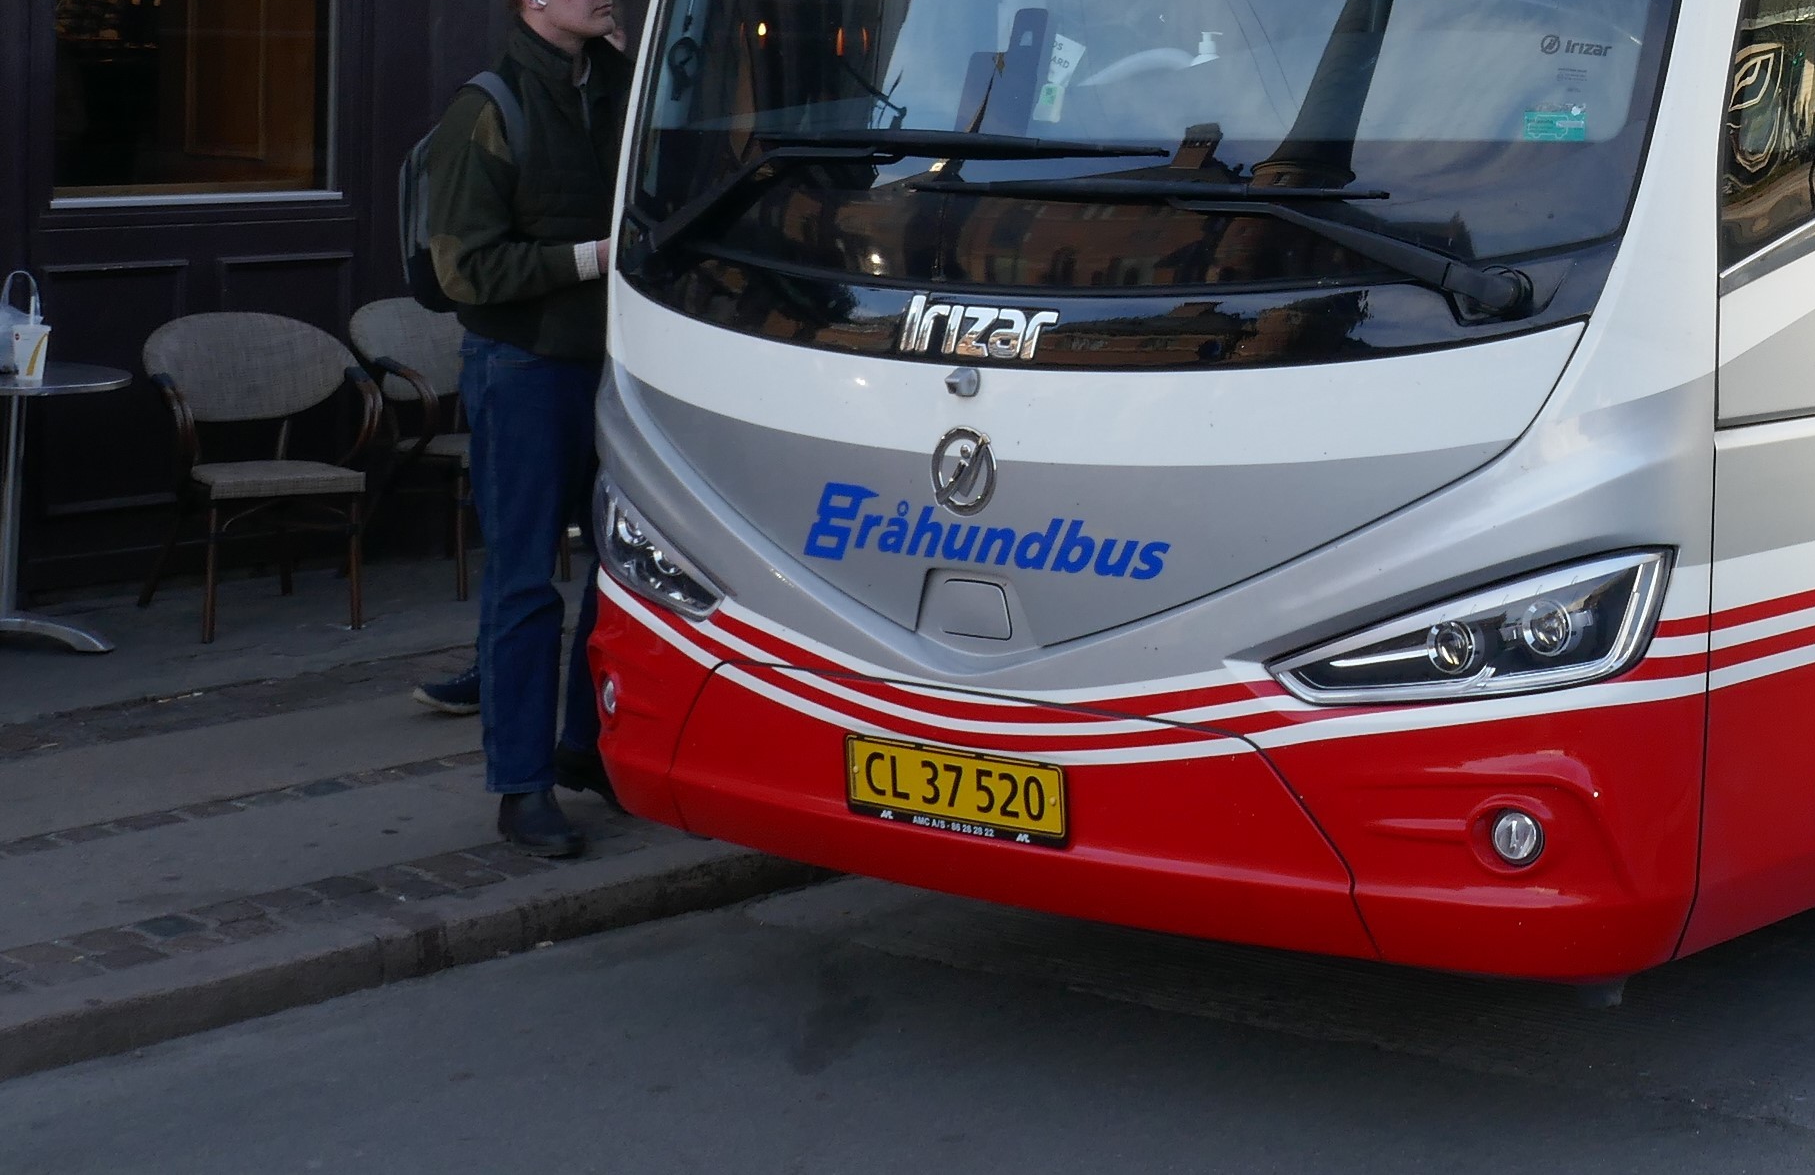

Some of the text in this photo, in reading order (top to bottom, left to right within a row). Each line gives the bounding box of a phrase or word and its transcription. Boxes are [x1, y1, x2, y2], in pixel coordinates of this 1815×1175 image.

[1564, 39, 1613, 57] Irizar
[900, 294, 1060, 360] Irizar
[865, 751, 1045, 822] CL 37 520
[912, 815, 930, 826] AMC
